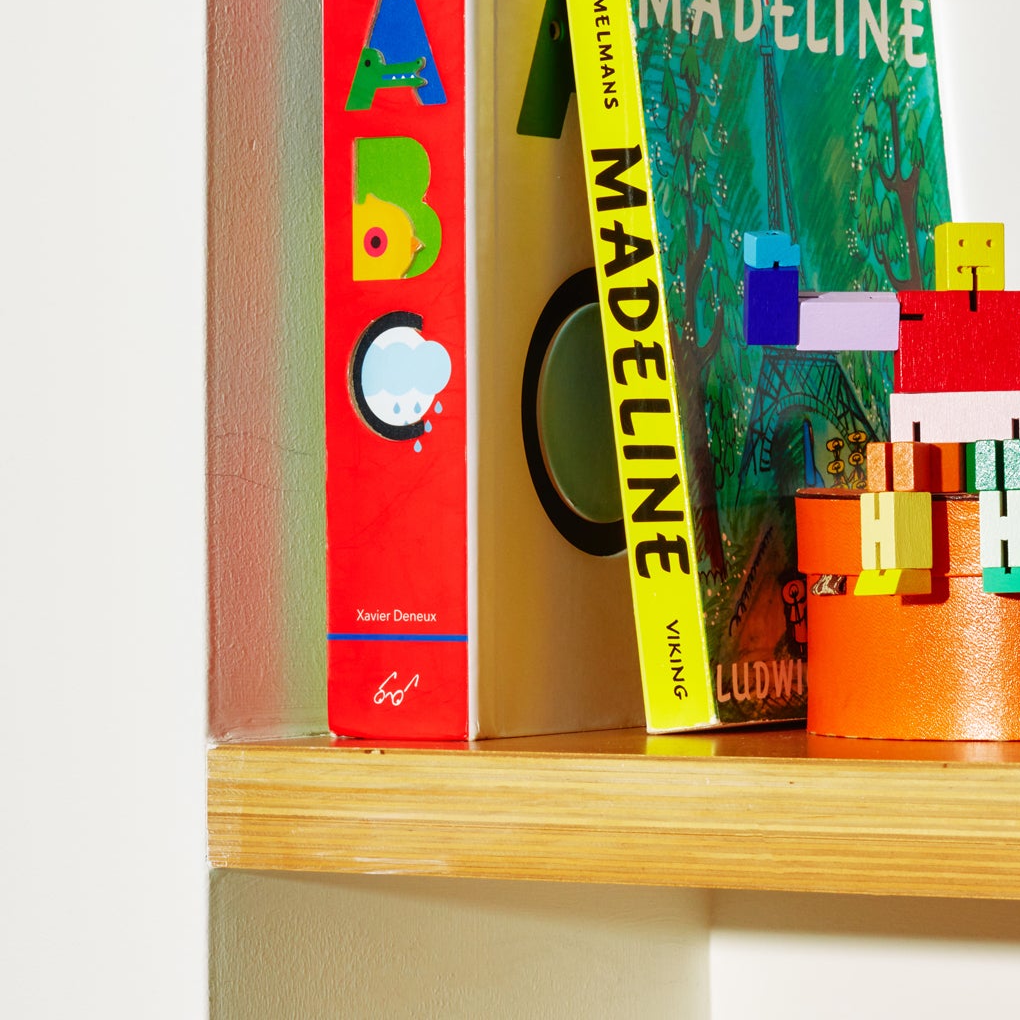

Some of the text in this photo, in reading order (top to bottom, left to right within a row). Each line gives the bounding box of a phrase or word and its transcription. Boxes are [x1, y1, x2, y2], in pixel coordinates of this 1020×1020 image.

[591, 144, 691, 579] MADELINE
[356, 609, 437, 623] Xavier Deneux
[666, 619, 688, 701] VIKING
[716, 659, 803, 703] LUDWI
